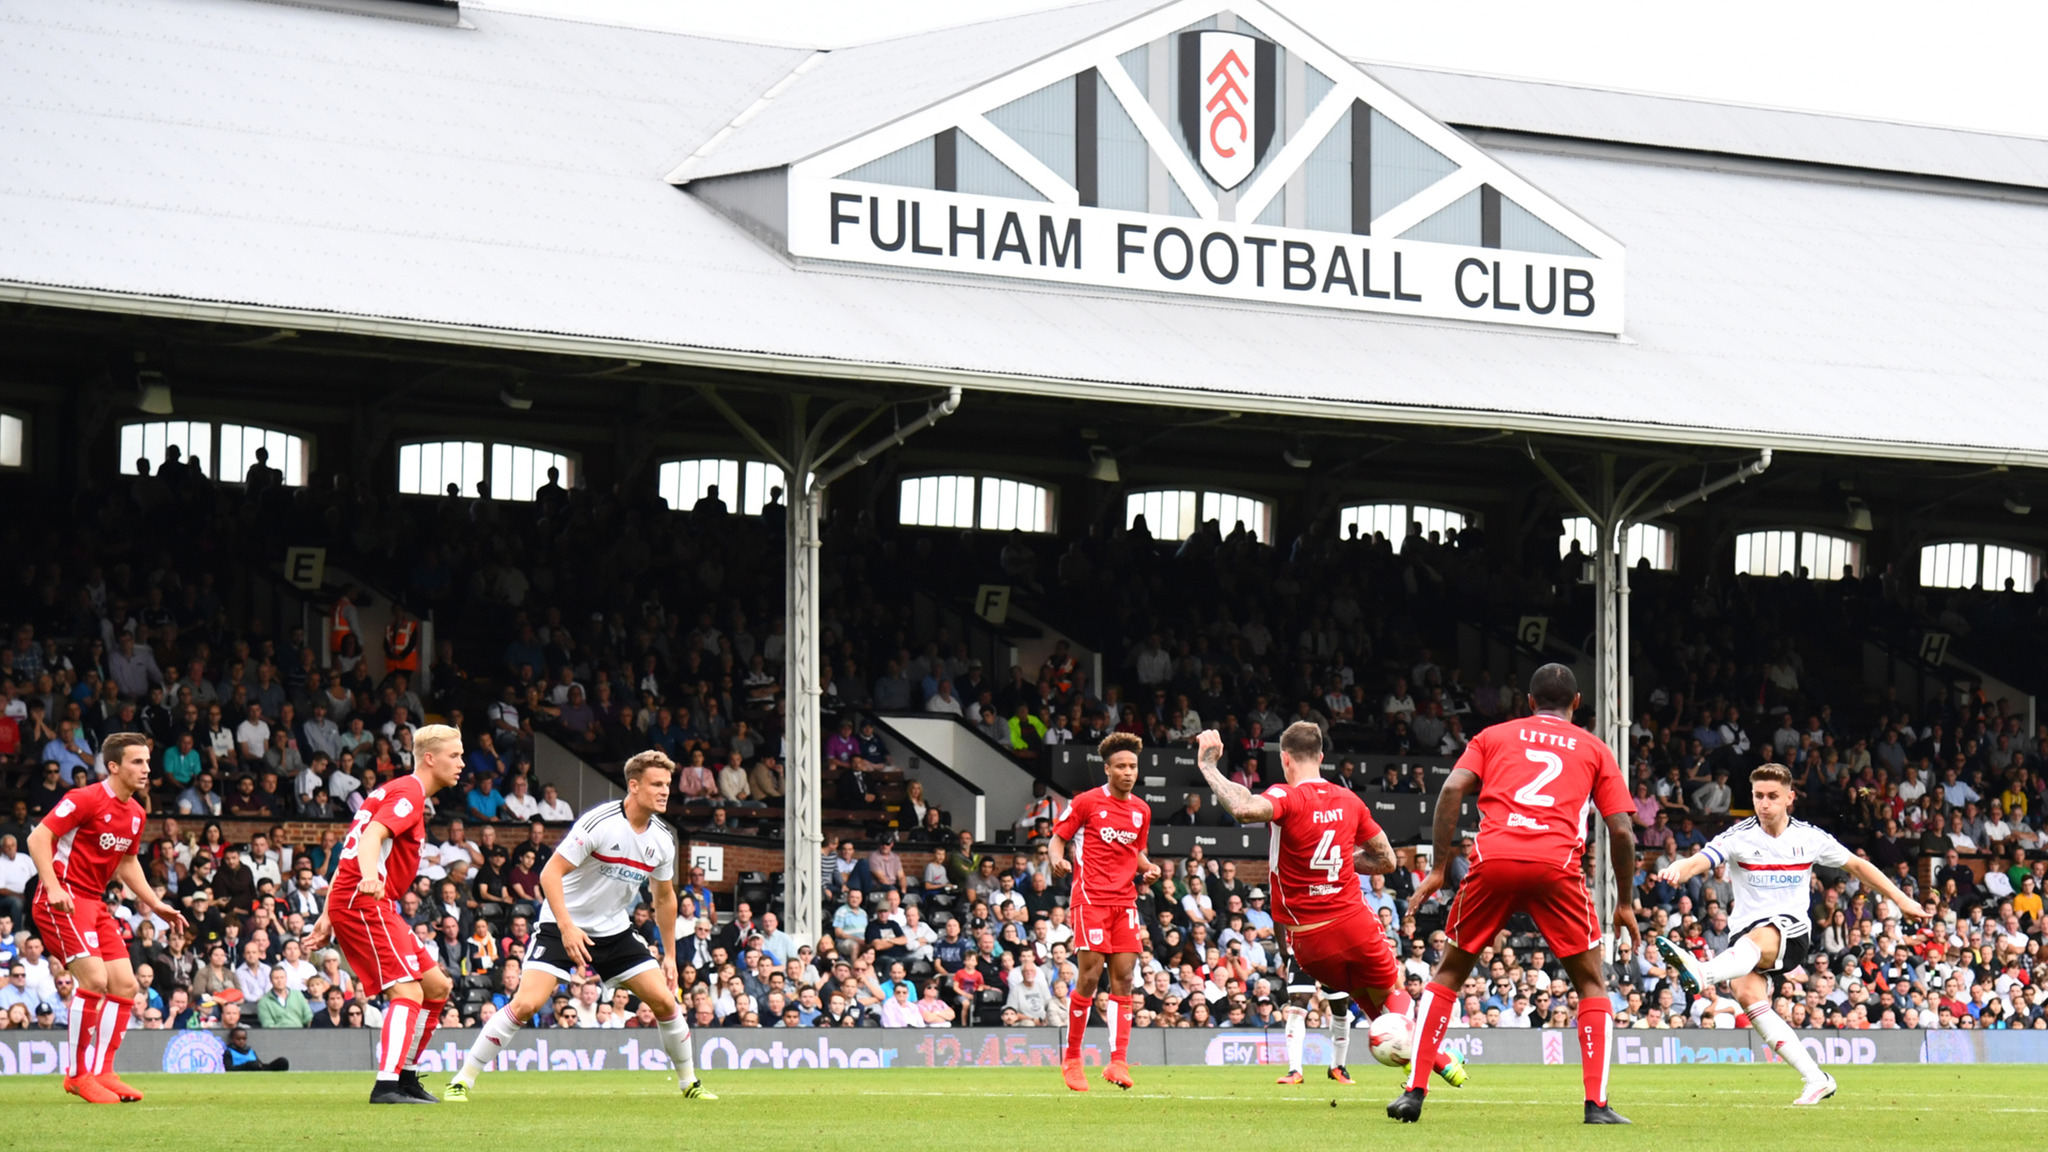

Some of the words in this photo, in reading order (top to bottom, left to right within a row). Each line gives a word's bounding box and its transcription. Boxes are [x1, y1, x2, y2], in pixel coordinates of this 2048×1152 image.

[829, 192, 1082, 269] FULHAM
[1117, 223, 1422, 303] FOOTBALL
[1454, 257, 1596, 317] CLUB
[293, 553, 316, 582] E
[982, 590, 1003, 616] F
[1522, 621, 1542, 646] G
[1924, 634, 1947, 663] H
[1519, 729, 1578, 751] LITTLE
[1175, 756, 1195, 765] Press
[1319, 763, 1336, 771] ress
[1513, 748, 1563, 808] 2
[1145, 794, 1166, 803] Press
[1376, 801, 1396, 811] Press
[1195, 835, 1217, 845] Press
[1310, 829, 1343, 882] 4
[1432, 1016, 1448, 1045] CITY
[1584, 1025, 1594, 1058] CITY
[700, 1036, 898, 1069] October
[1225, 1042, 1254, 1065] sky
[1617, 1037, 1754, 1064] Fulham
